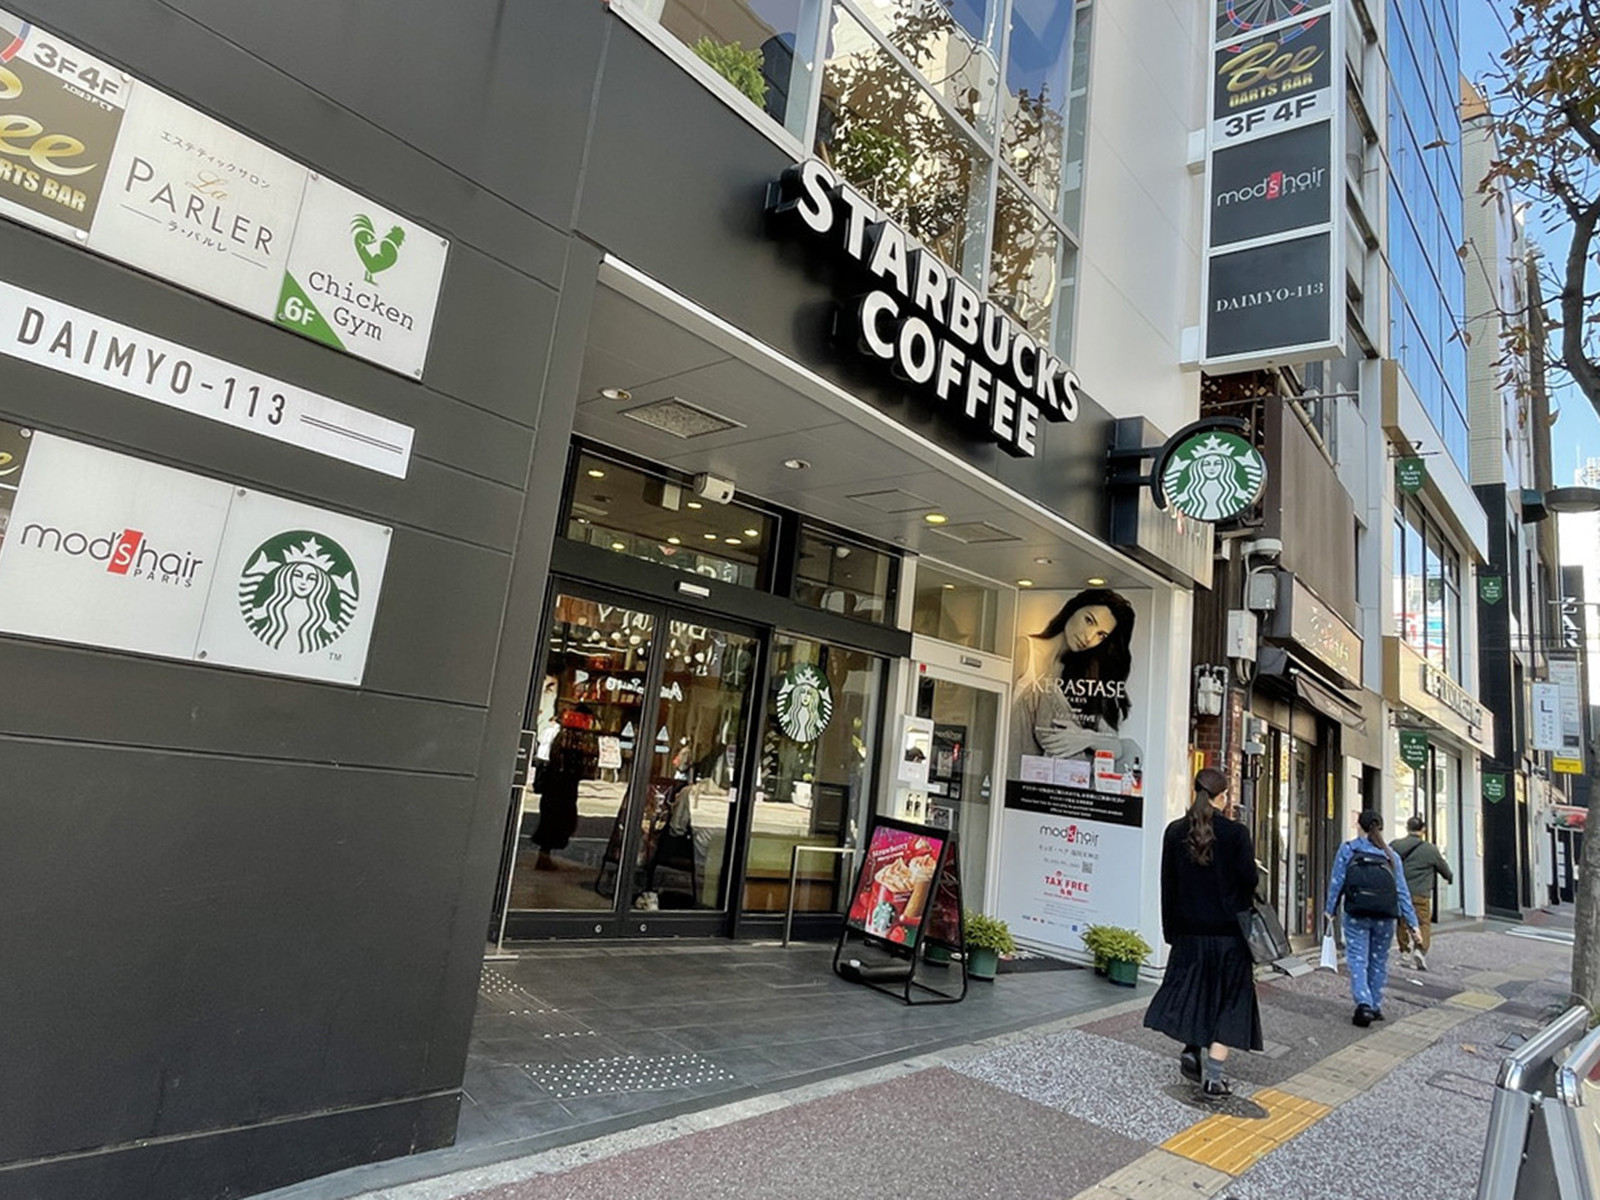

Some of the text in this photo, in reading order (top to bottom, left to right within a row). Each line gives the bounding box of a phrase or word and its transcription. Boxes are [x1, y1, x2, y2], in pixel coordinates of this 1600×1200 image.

[1218, 41, 1325, 91] Bee
[1229, 72, 1313, 107] DARTS BAR
[1225, 94, 1317, 137] 3F 4F
[161, 131, 270, 188] エステティックサロン
[42, 177, 87, 213] BAR
[185, 170, 228, 199] La
[125, 157, 273, 255] PARLER
[308, 271, 415, 331] Chicken
[797, 158, 1081, 422] STARBUCKS
[1216, 283, 1324, 312] DAIMYO-113
[283, 297, 316, 326] 6F
[333, 308, 383, 342] Gym
[17, 307, 287, 425] DAIMYO-113
[862, 289, 1039, 457] COFFEE
[133, 568, 193, 588] PARIS
[328, 651, 342, 661] TM
[1045, 875, 1062, 887] TAX
[1065, 880, 1090, 892] FREE
